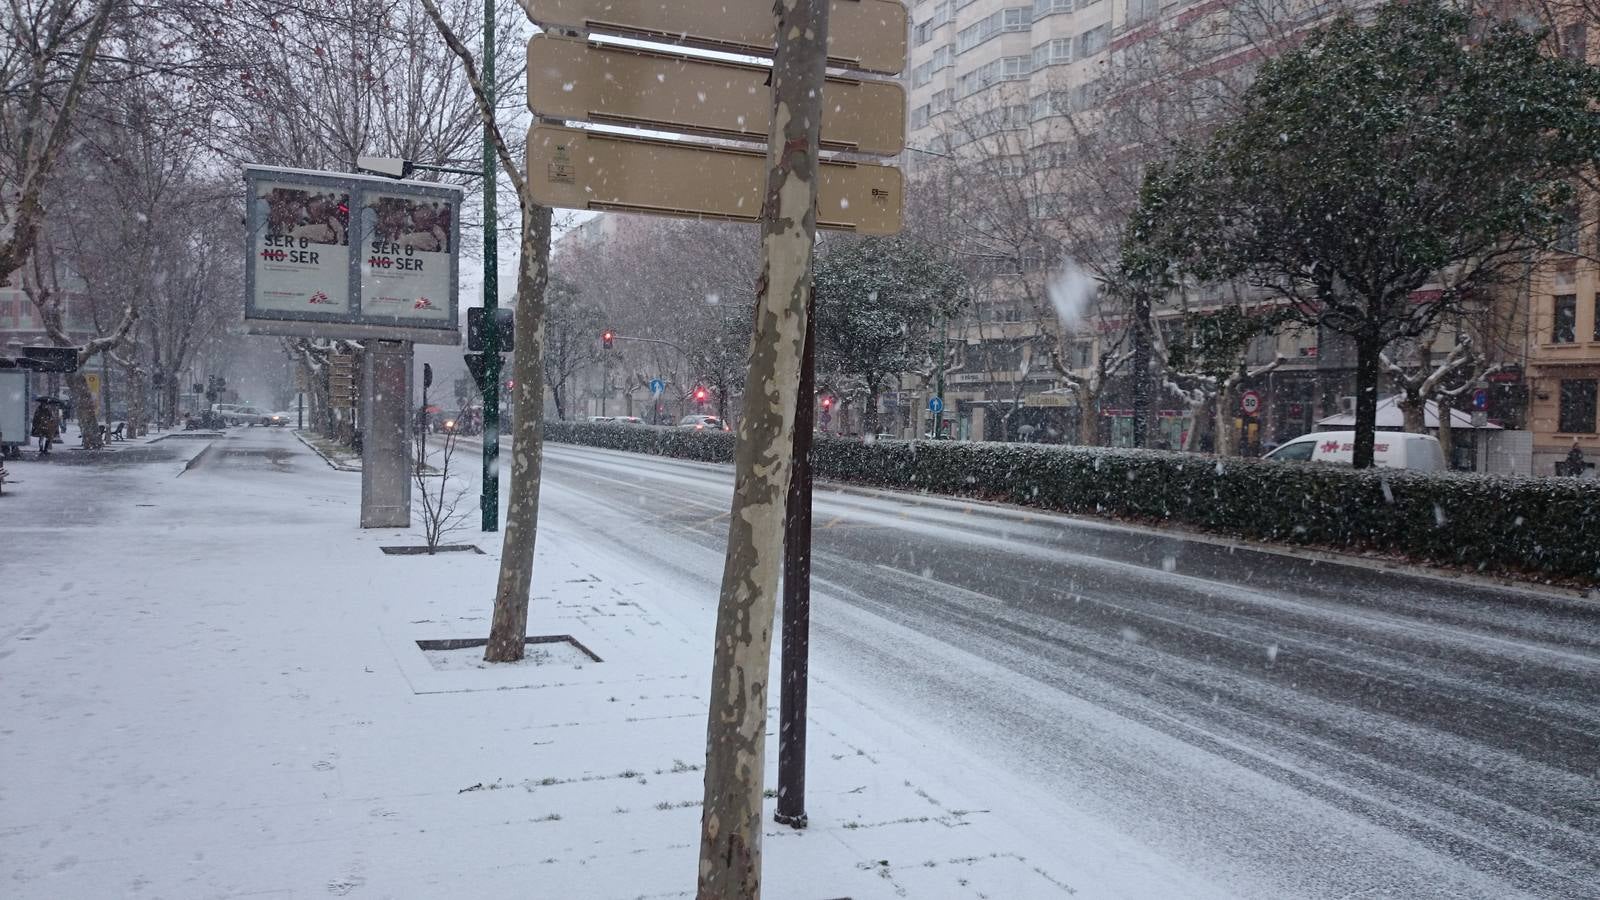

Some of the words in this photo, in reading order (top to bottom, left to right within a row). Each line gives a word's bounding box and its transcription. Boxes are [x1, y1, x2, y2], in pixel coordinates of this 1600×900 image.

[264, 234, 294, 248] SER
[371, 241, 400, 255] SER
[263, 249, 285, 262] NO
[289, 250, 319, 264] SER
[371, 256, 391, 269] NO
[396, 257, 423, 271] SER
